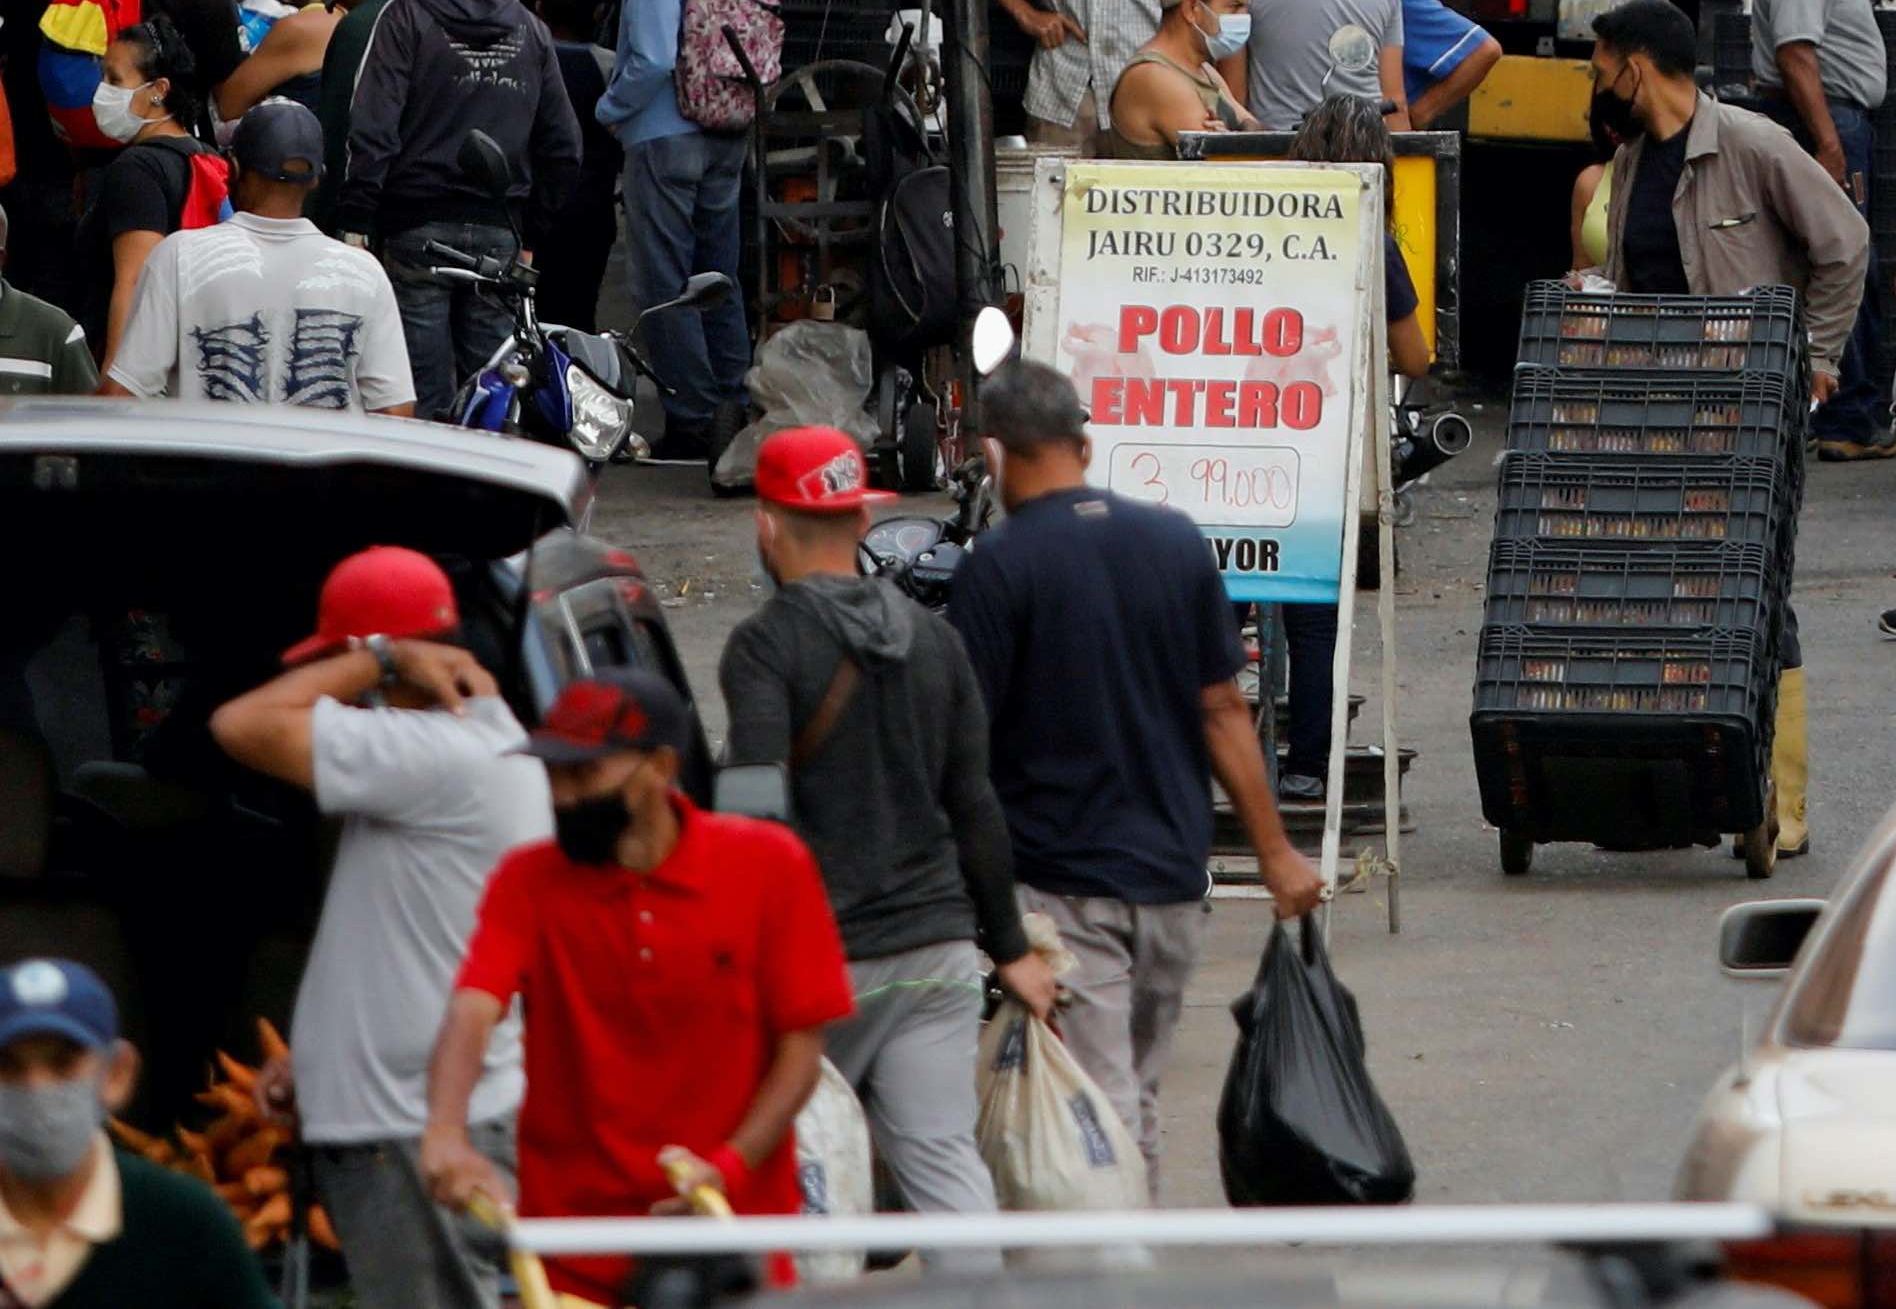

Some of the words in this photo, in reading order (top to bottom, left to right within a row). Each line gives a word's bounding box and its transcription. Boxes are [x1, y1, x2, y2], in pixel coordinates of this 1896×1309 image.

[1085, 187, 1345, 219] DISTRIBUIDORA
[1087, 229, 1176, 261] JAIRU
[1185, 232, 1272, 262] 0329,
[1281, 234, 1338, 261] C.A.
[1132, 266, 1166, 283] RIF.:
[1170, 267, 1264, 285] J-413173492
[1117, 304, 1305, 358] POLLO
[1089, 376, 1325, 431] ENTERO
